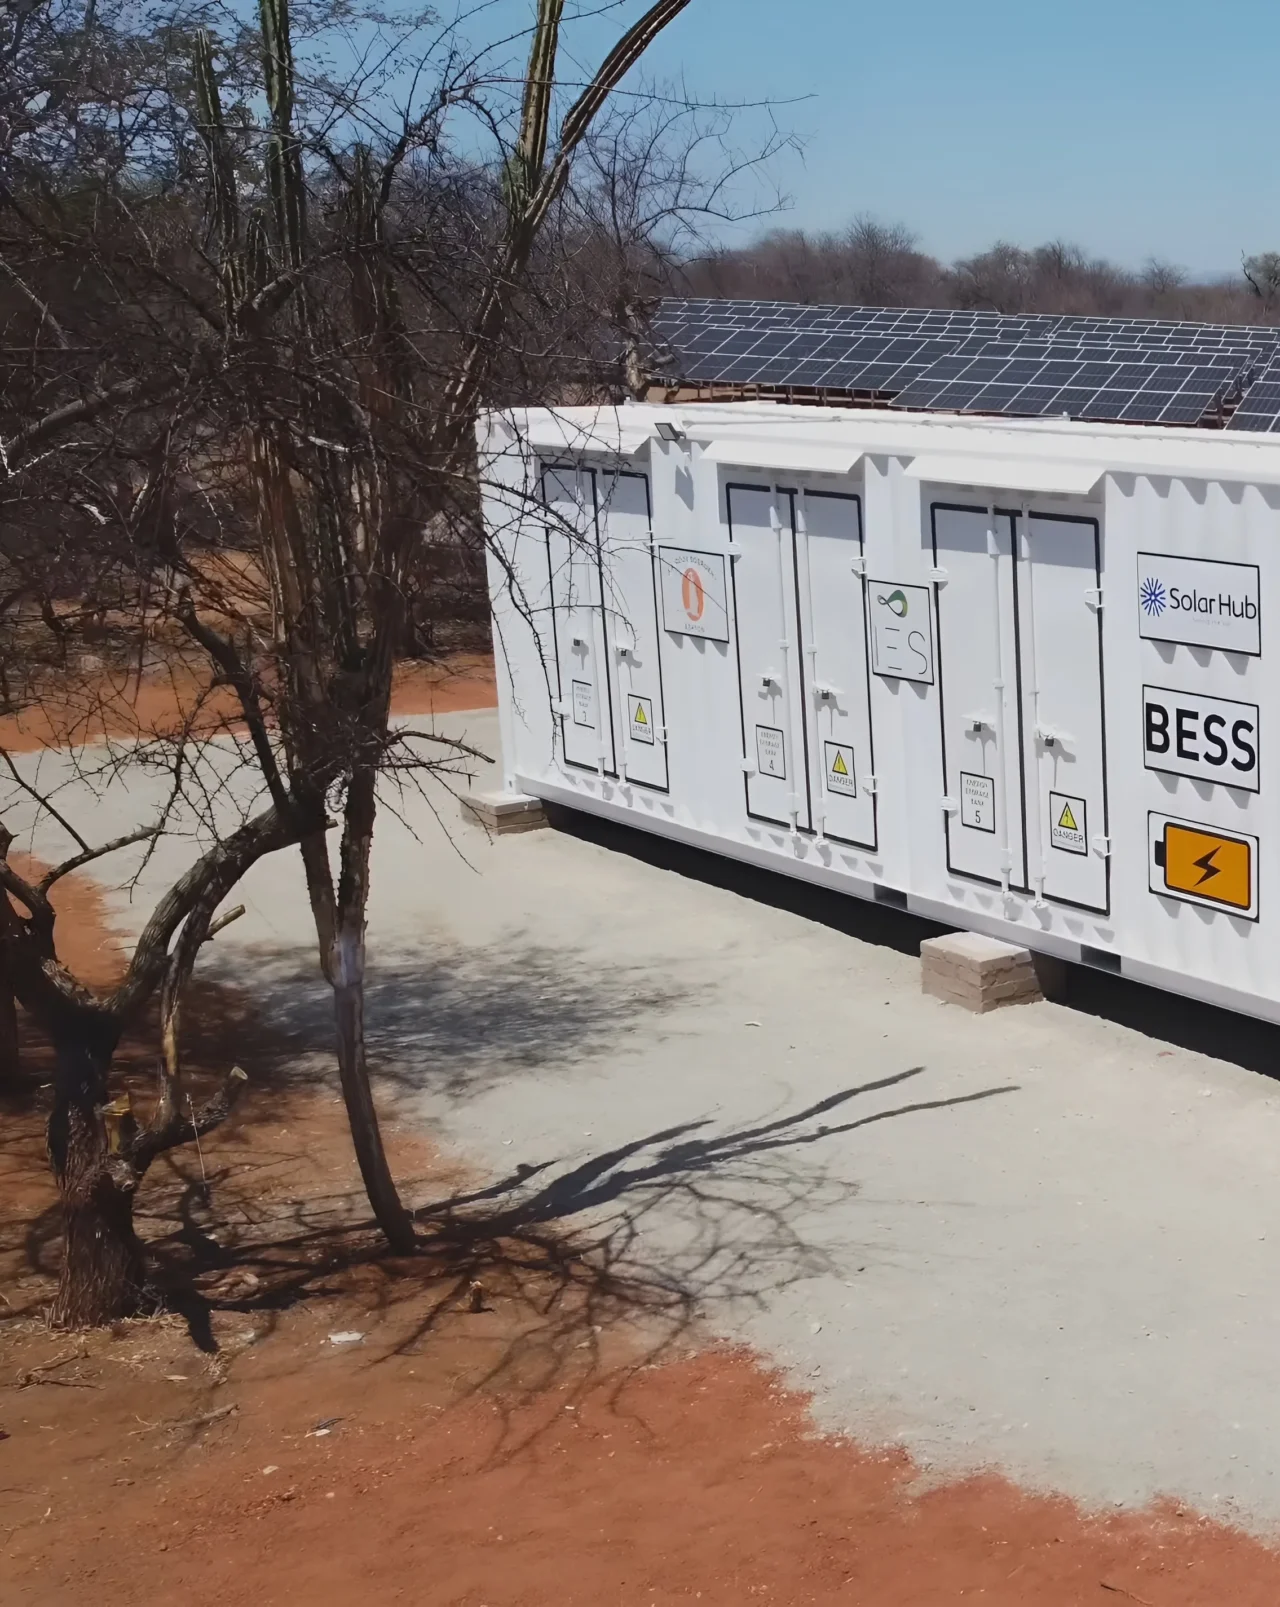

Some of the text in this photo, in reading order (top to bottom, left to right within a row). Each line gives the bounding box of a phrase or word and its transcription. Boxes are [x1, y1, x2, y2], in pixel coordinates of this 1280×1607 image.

[1145, 702, 1256, 772] BESS
[769, 759, 775, 771] 4
[829, 774, 853, 786] DANGER
[975, 810, 981, 824] 5
[1052, 828, 1084, 844] DANGER
